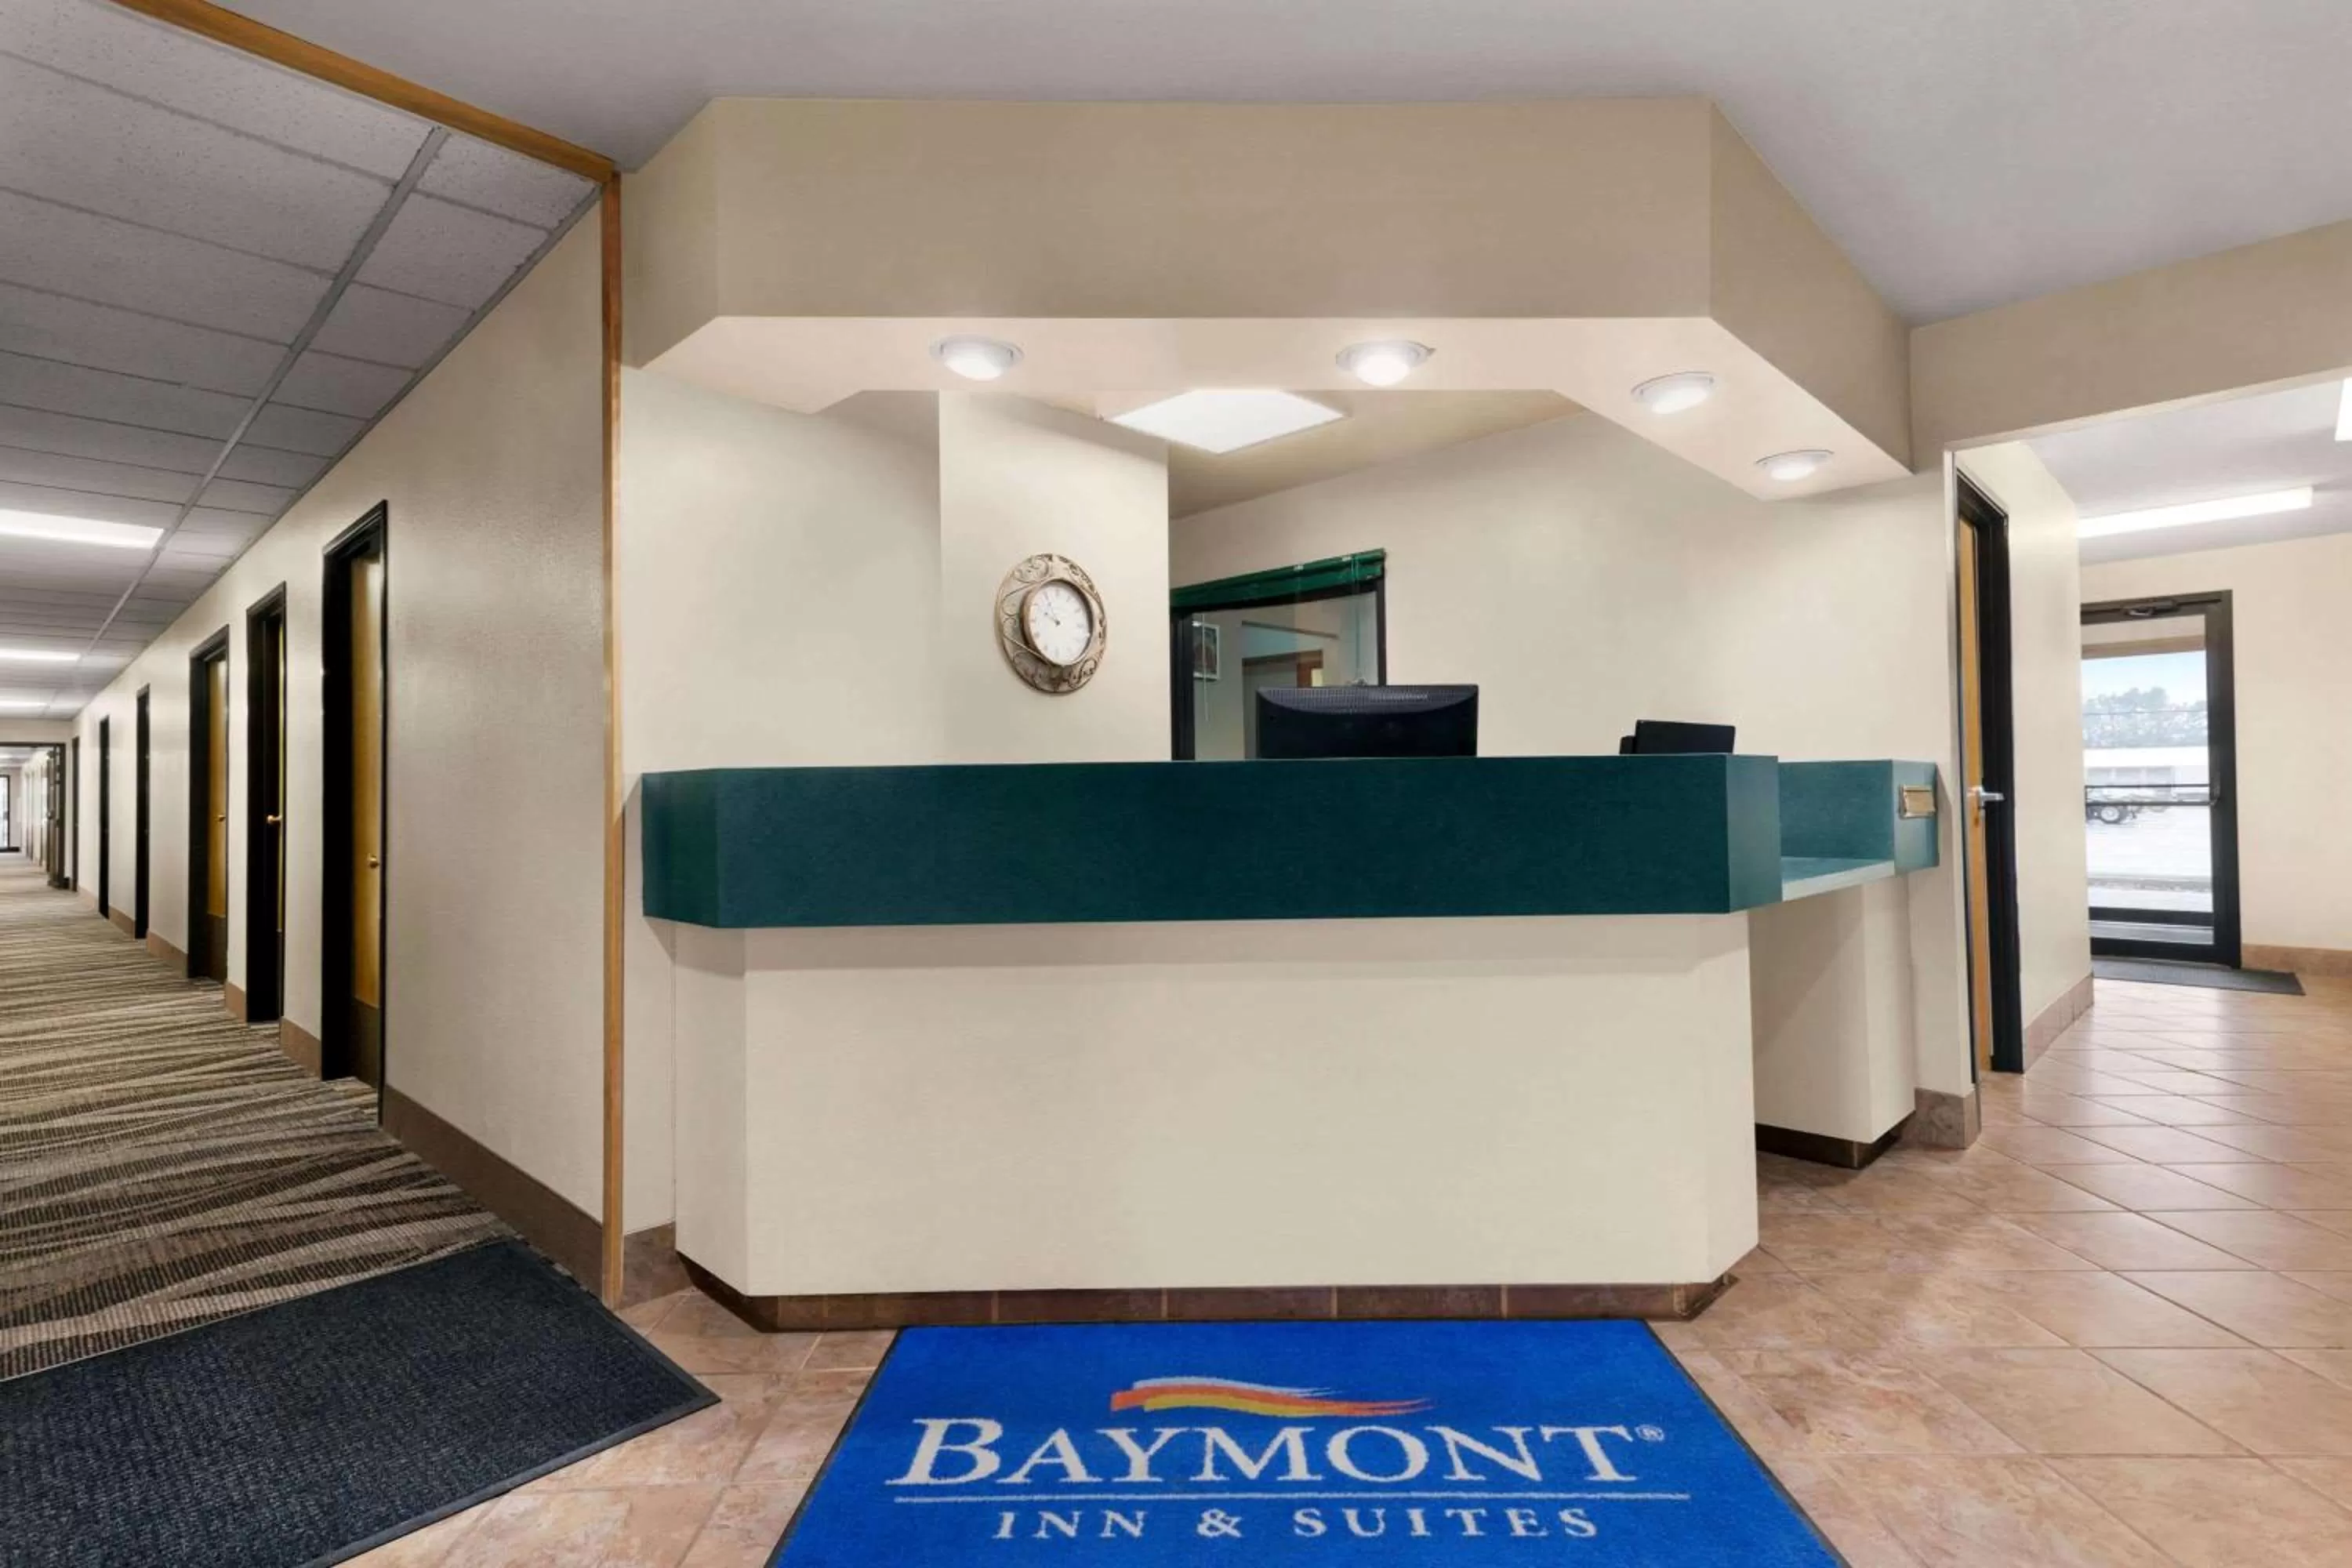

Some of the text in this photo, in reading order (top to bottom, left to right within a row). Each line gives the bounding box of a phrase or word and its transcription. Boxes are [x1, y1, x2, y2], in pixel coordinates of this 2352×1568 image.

[996, 1508, 1598, 1539] INN & SUITES
